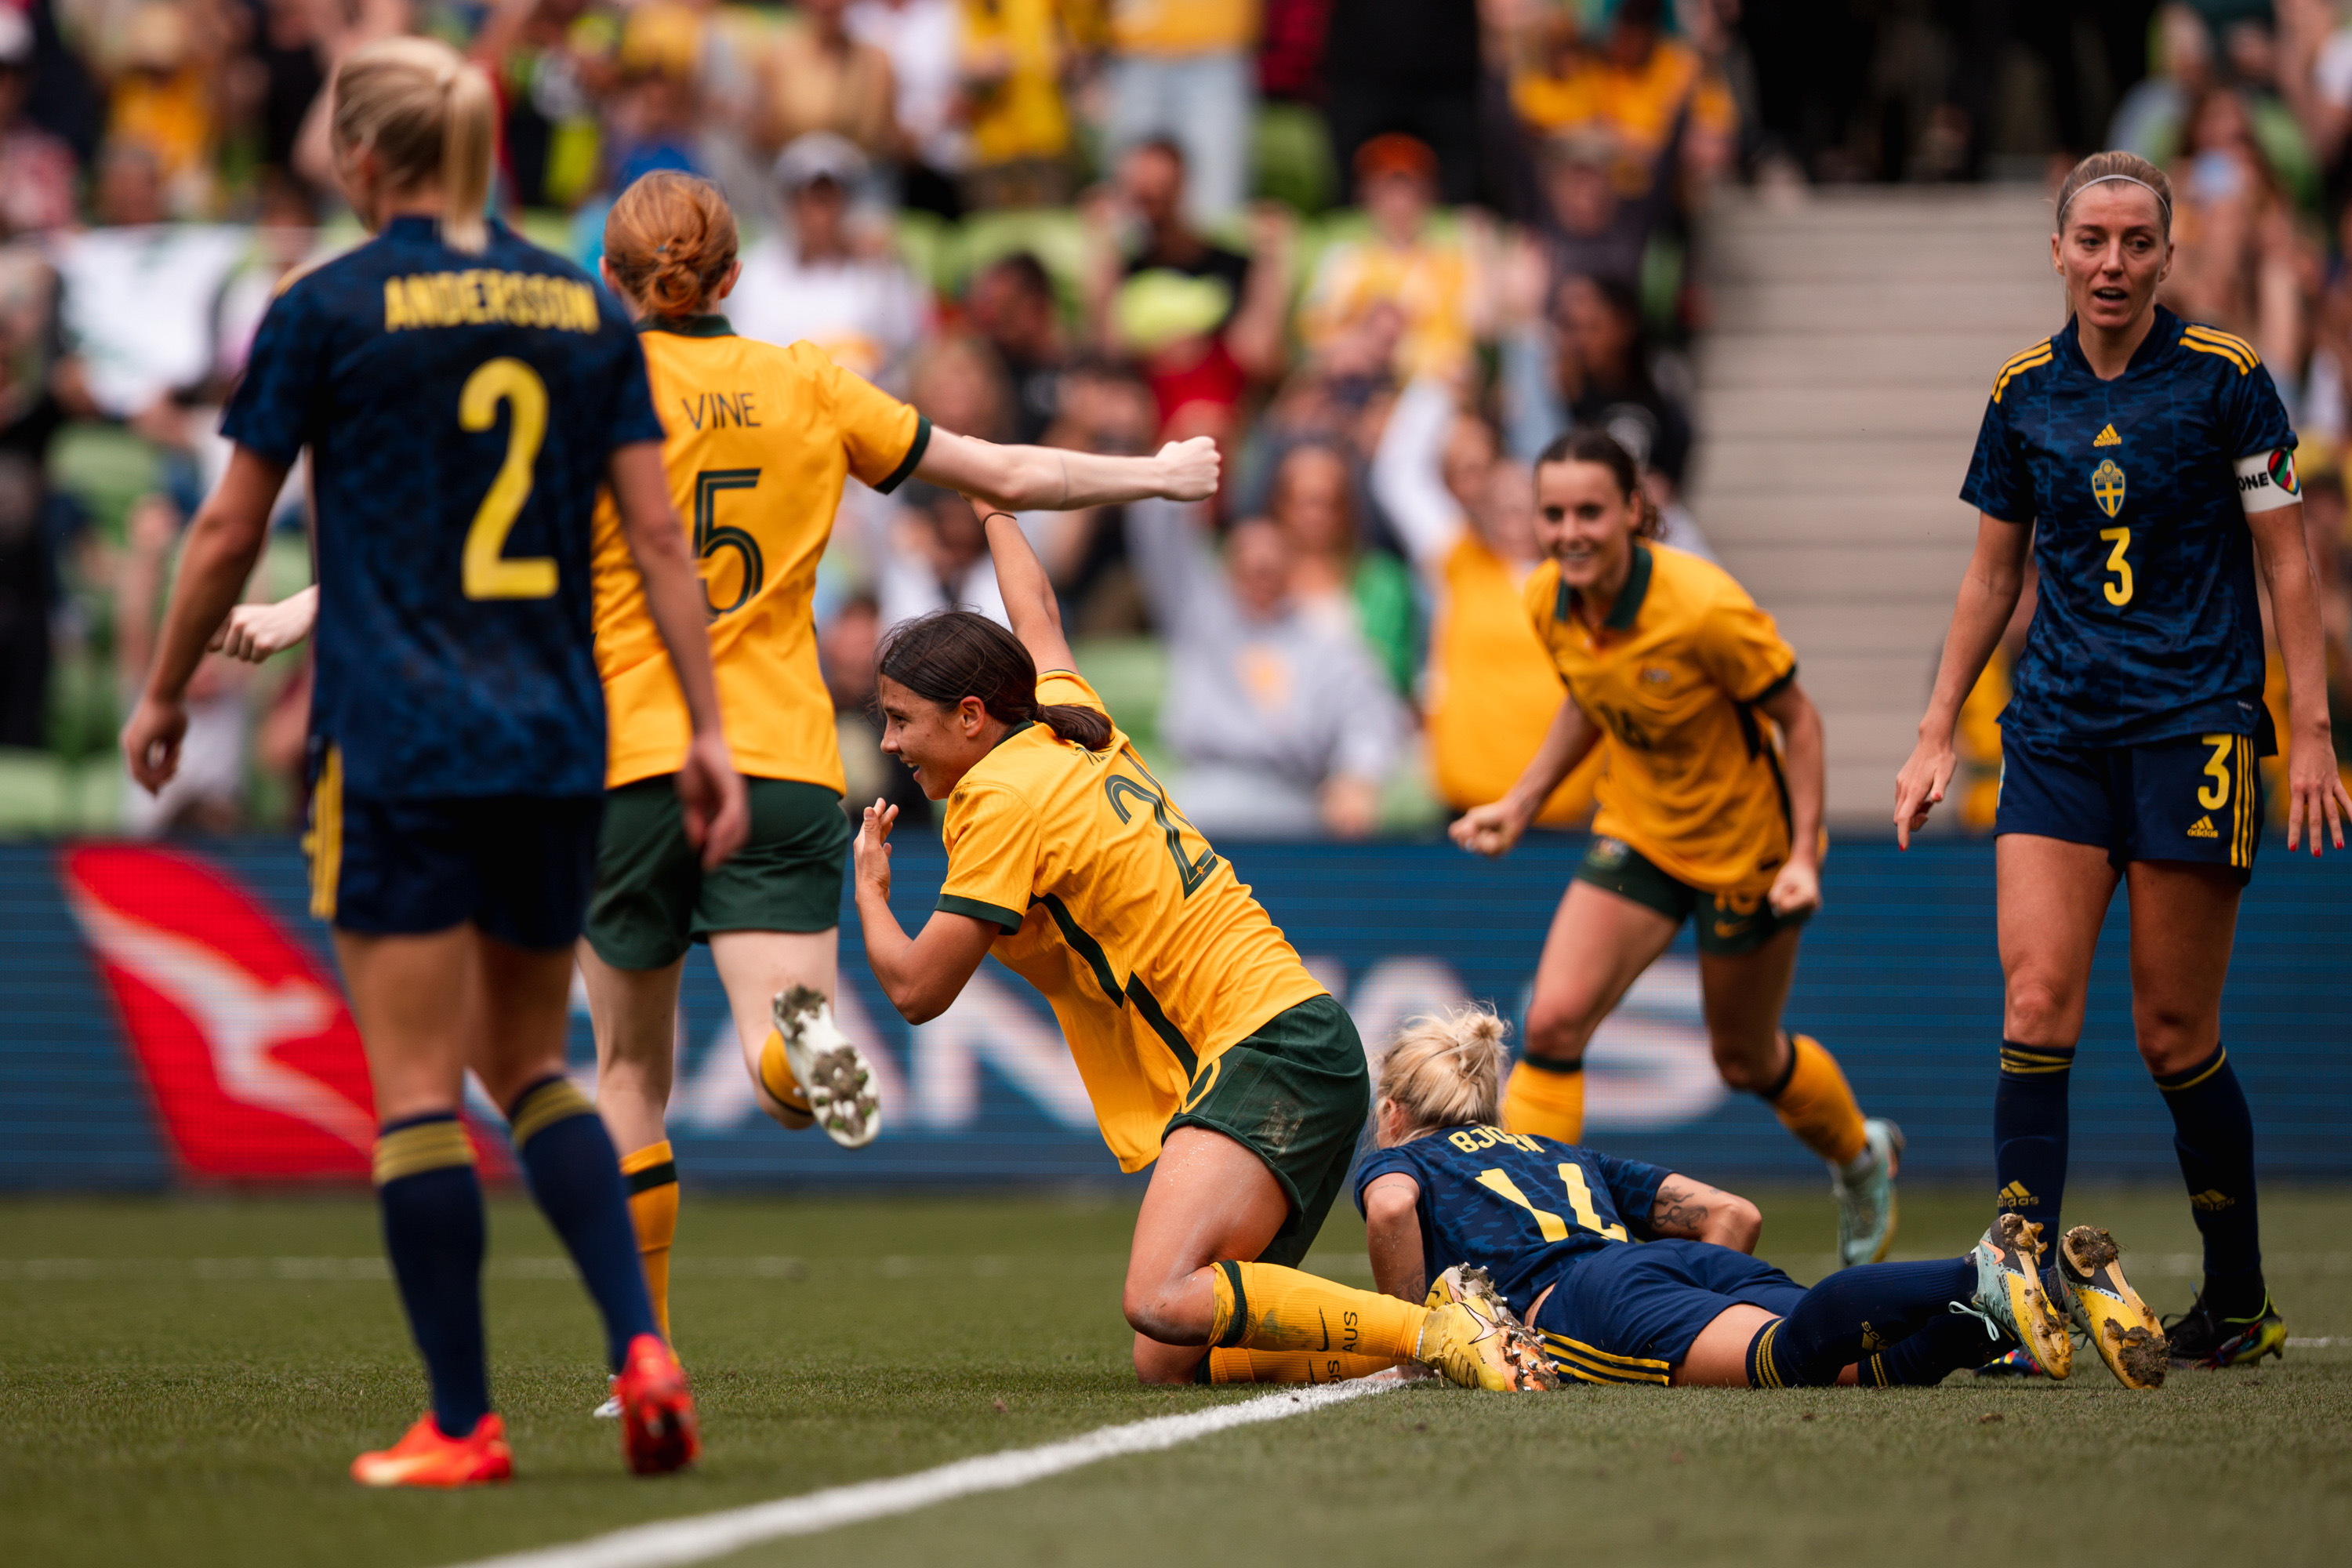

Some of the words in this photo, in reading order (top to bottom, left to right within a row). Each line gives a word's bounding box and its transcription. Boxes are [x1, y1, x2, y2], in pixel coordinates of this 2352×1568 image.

[384, 268, 601, 335] ANDERSSON
[682, 393, 761, 430] VINE
[458, 357, 559, 601] 2
[2238, 470, 2270, 492] ONE
[691, 468, 763, 618] 5
[2100, 526, 2133, 606] 3
[2198, 733, 2233, 811] 3
[1105, 749, 1219, 900] 2
[2187, 829, 2219, 838] adidas
[1342, 1311, 1358, 1352] AUS
